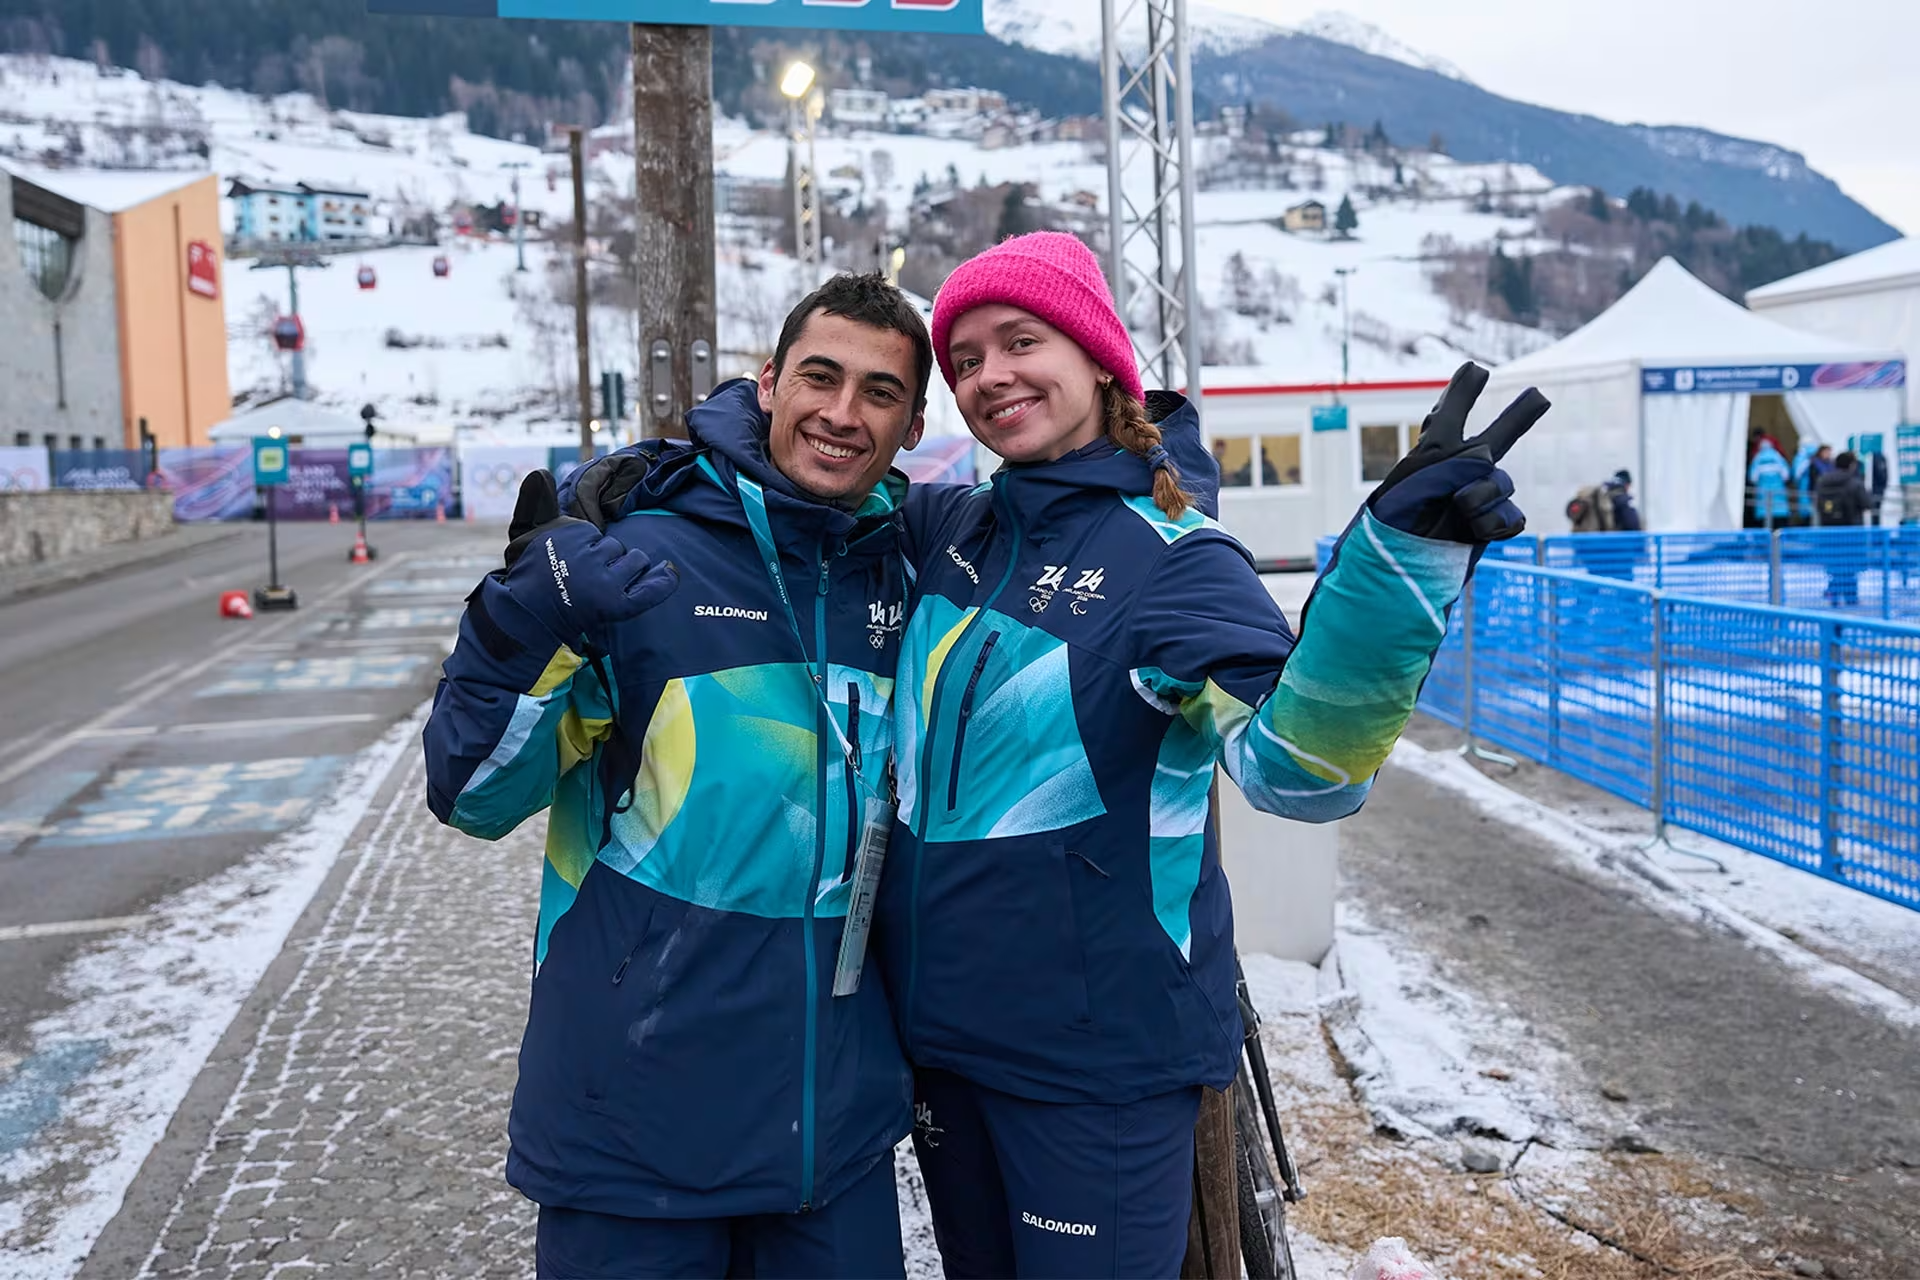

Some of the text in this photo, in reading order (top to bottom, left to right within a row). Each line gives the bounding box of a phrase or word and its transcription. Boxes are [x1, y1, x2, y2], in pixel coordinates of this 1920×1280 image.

[545, 537, 572, 607] MILANO CORTINA
[946, 544, 980, 584] OMON
[694, 605, 768, 621] SALOMON
[1022, 1211, 1097, 1236] SALOMON
